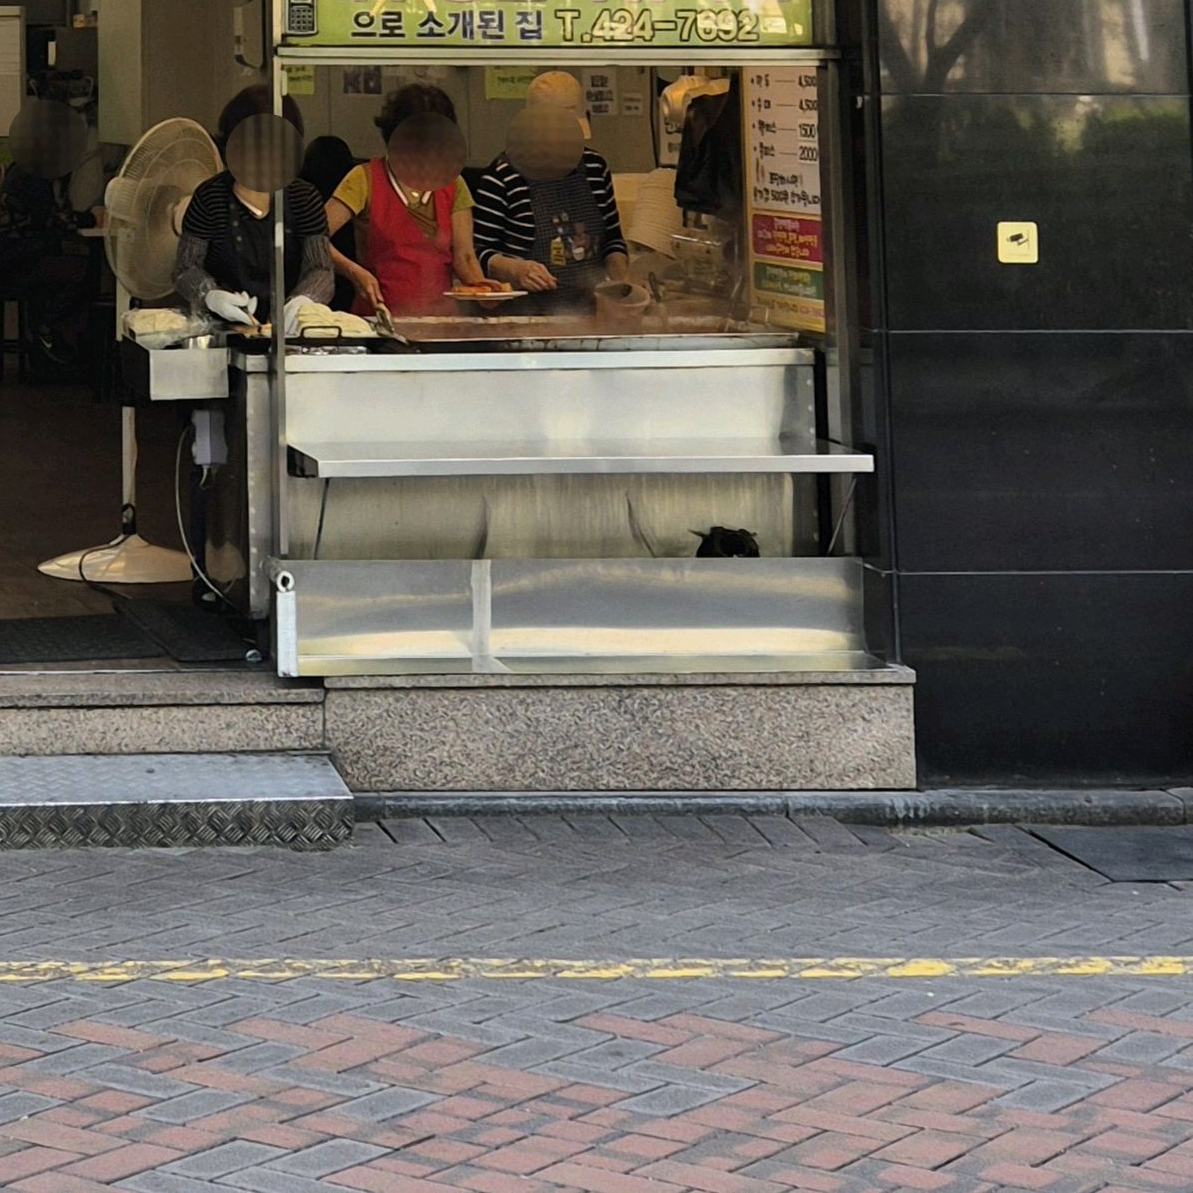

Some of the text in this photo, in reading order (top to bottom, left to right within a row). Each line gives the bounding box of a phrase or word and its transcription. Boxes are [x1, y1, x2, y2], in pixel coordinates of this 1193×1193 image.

[350, 10, 405, 40] 으로
[416, 9, 506, 41] 소개된
[515, 10, 544, 42] 집
